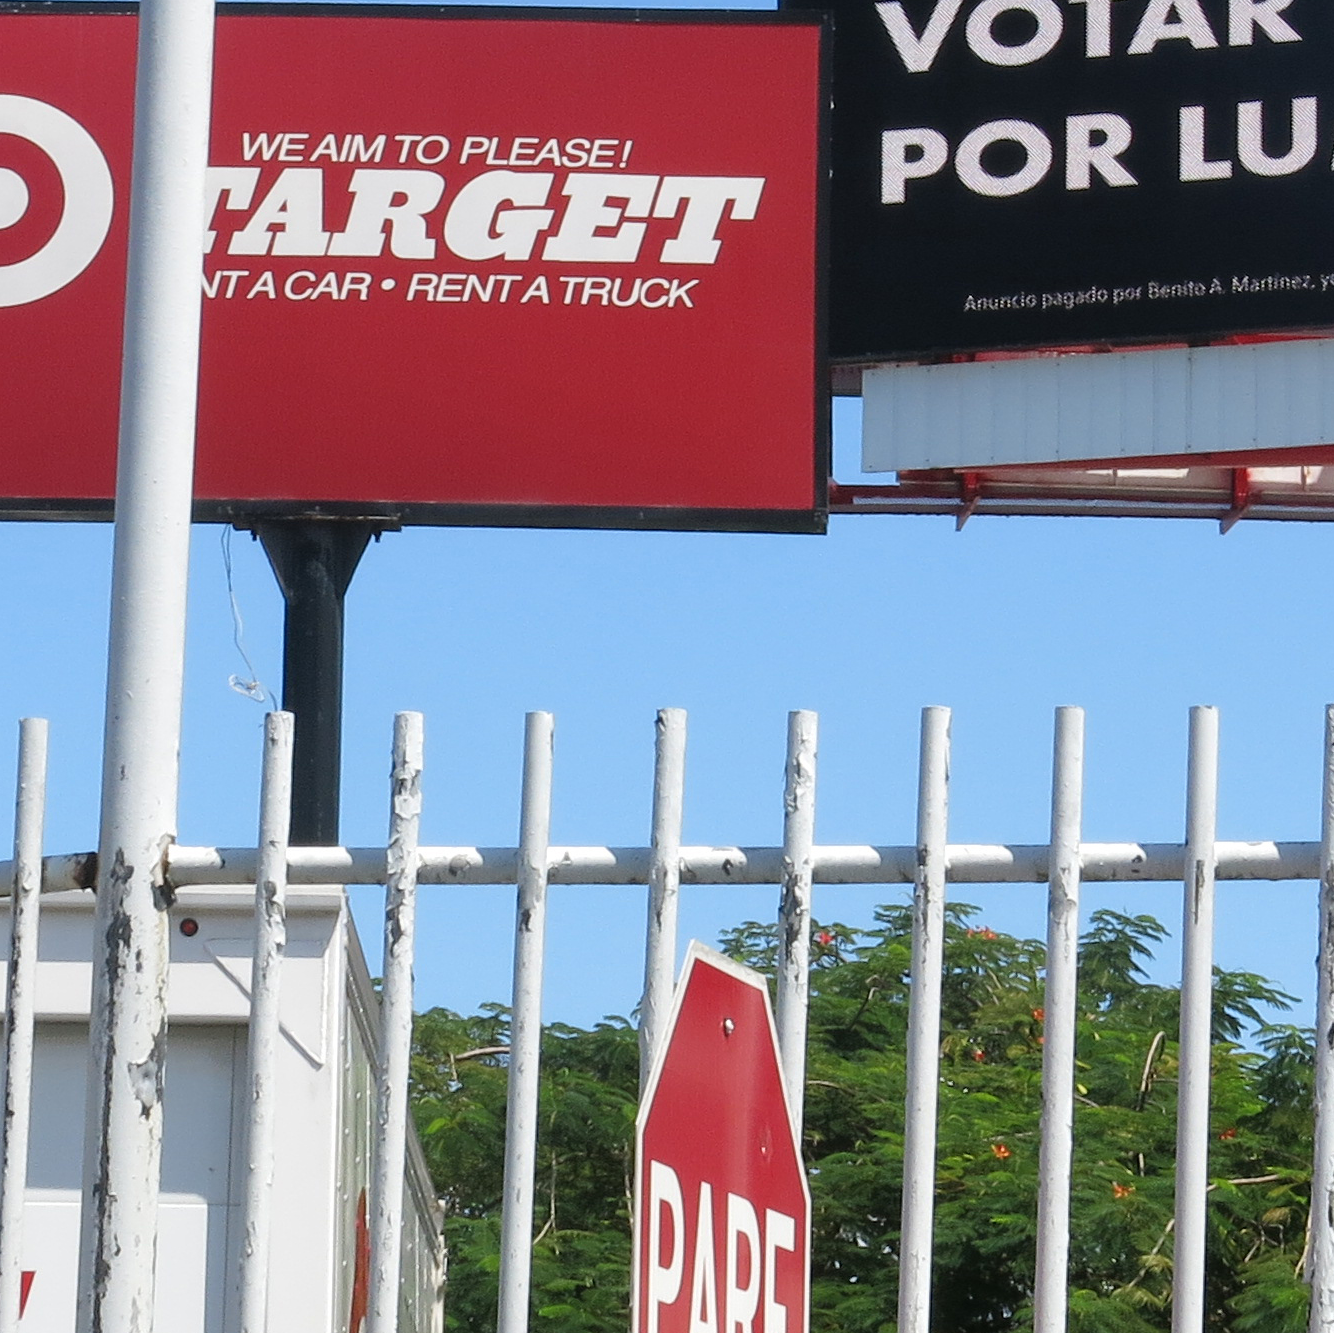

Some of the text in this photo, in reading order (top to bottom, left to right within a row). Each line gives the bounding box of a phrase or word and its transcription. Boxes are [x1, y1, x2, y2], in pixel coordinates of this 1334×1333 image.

[241, 131, 634, 169] WE AIM TO PLEASE!
[880, 111, 1139, 204] POR
[201, 270, 701, 308] NT A CAR RENT A TRUCK
[963, 291, 1037, 312] Anuncio
[1041, 285, 1109, 311] pagado
[1112, 285, 1142, 306] por
[1147, 279, 1207, 301] Benito
[1208, 276, 1226, 296] A.
[647, 1159, 796, 1333] PARE
